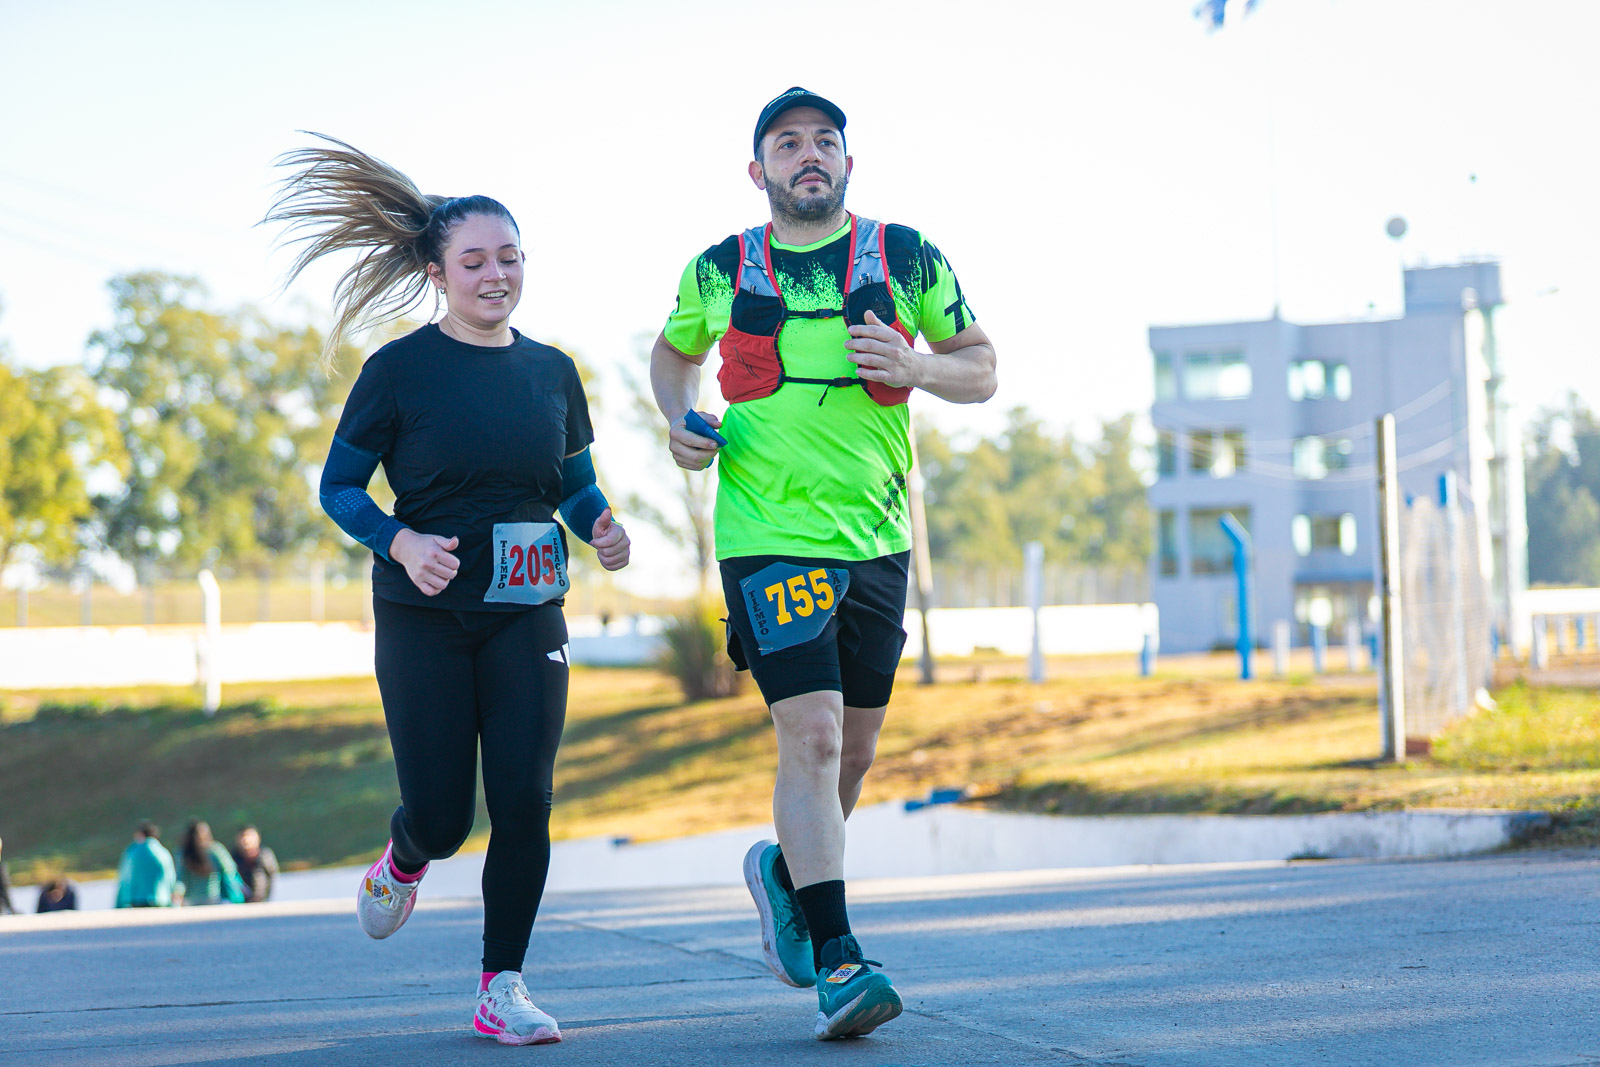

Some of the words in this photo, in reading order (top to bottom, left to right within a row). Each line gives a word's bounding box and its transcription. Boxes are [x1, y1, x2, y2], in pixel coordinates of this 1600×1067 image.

[497, 540, 508, 590] TIEMPO
[508, 544, 556, 586] 205
[553, 538, 565, 587] EXACTO
[764, 568, 834, 626] 755
[829, 569, 842, 606] XACT
[747, 590, 770, 636] TIEMPO
